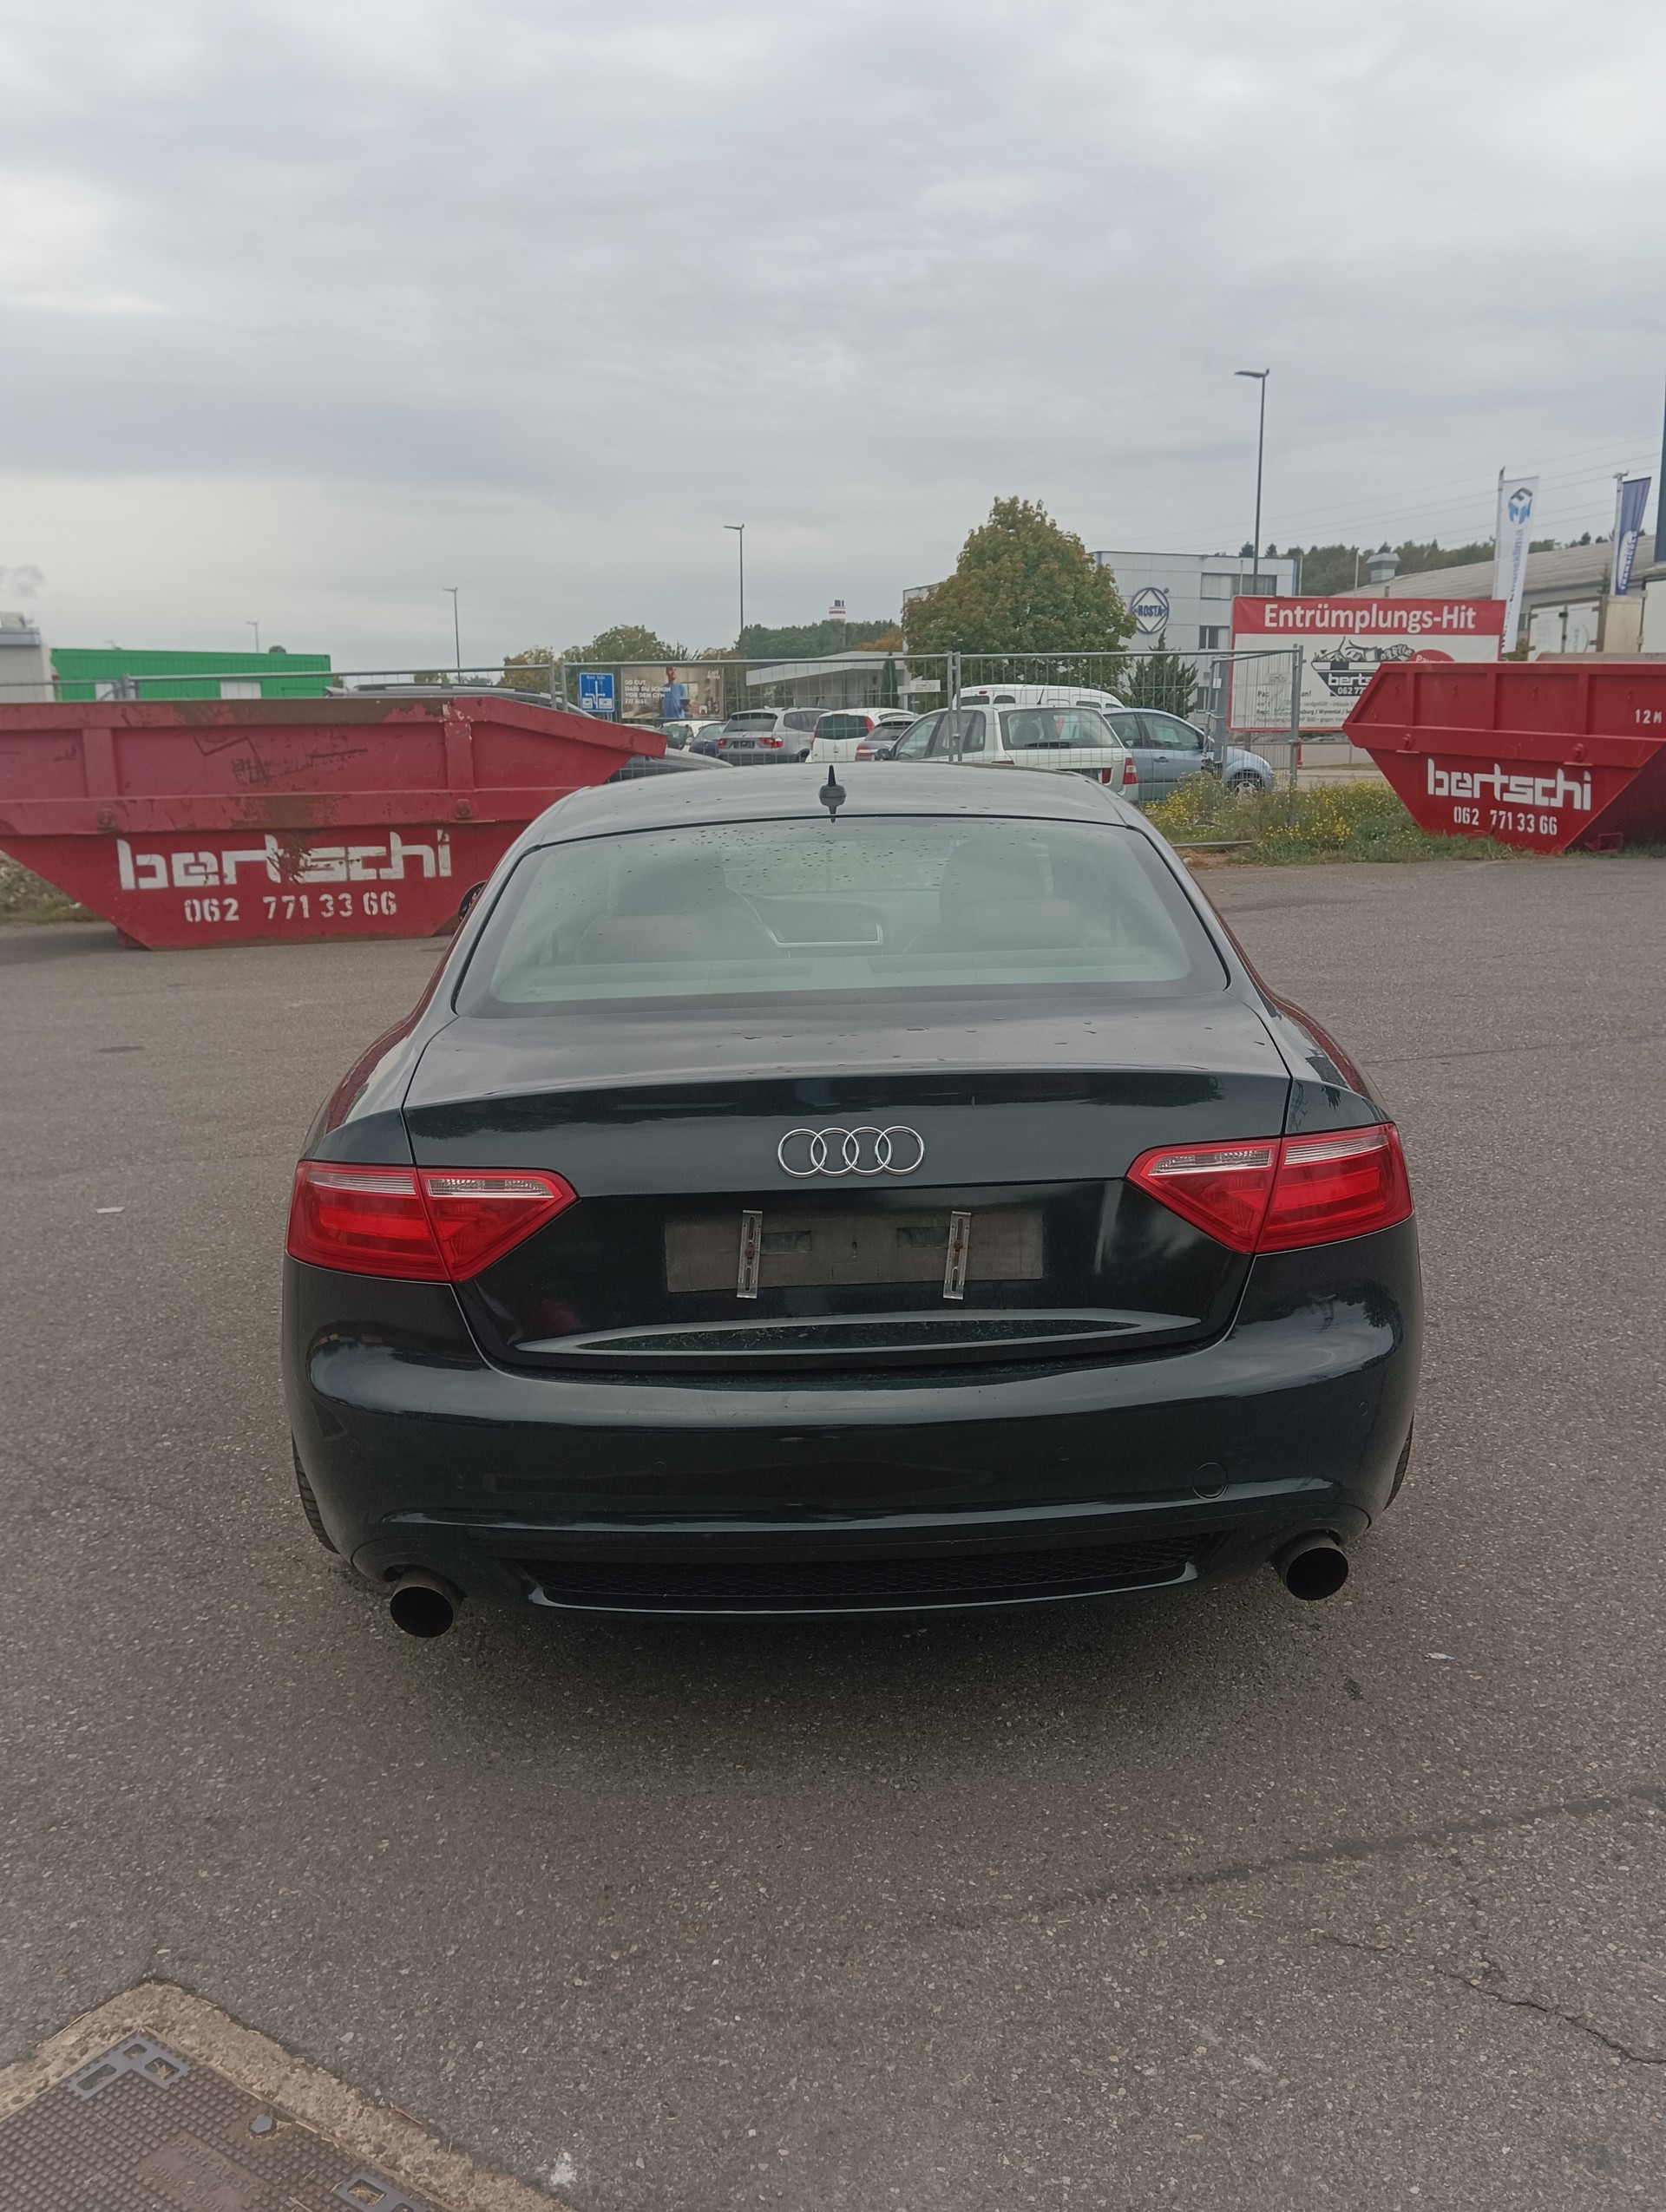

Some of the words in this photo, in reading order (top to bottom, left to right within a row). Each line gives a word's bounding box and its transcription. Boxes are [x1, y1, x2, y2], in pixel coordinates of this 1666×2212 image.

[1138, 605, 1163, 617] ROSTA
[1264, 604, 1477, 633] Entrümplungs-Hit
[1328, 673, 1373, 686] berts
[1427, 758, 1591, 810] bertschi
[1453, 806, 1480, 826] 062
[1490, 809, 1513, 830] 771
[1517, 812, 1536, 833] 33
[1539, 815, 1558, 835] 66
[116, 829, 452, 890] bertschi
[184, 897, 240, 923] 062
[262, 894, 311, 919] 771
[318, 893, 354, 919] 33
[362, 891, 397, 916] 66
[171, 2137, 262, 2195] PREFAEST
